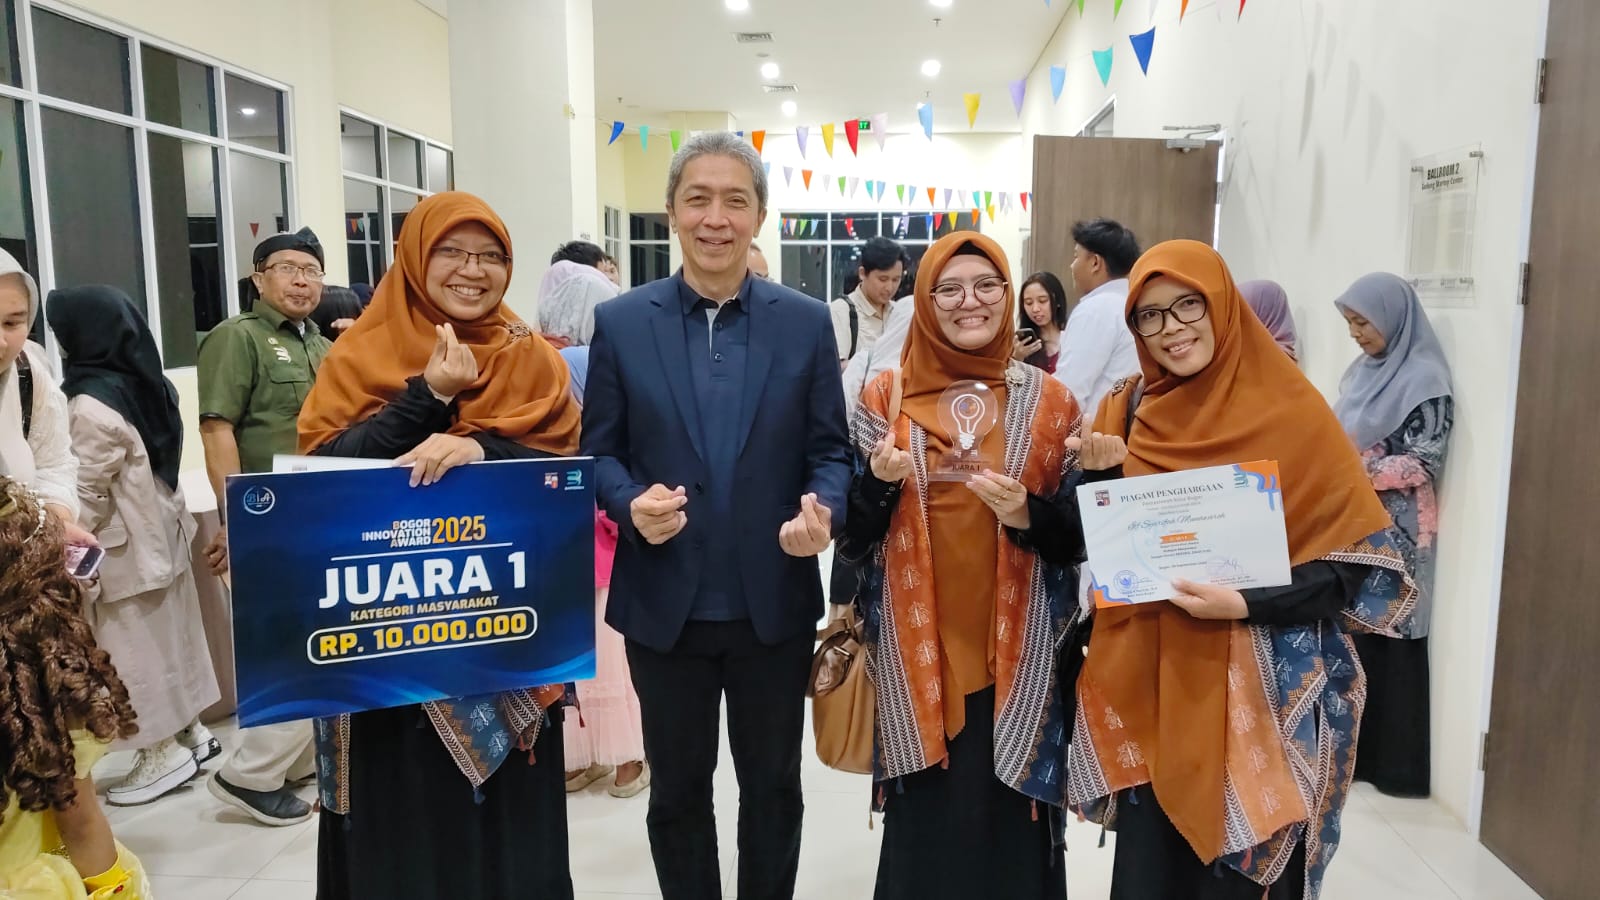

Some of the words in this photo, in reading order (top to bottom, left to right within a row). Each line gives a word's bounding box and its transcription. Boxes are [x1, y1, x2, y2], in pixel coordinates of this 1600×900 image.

[1427, 163, 1455, 180] BALLROOM
[1455, 162, 1460, 175] 2
[952, 464, 975, 472] JUARA
[1120, 491, 1154, 503] PIAGAM
[1156, 482, 1224, 498] PENGHARGAAN
[392, 518, 431, 530] BOGOR
[432, 515, 487, 544] 2025
[361, 527, 431, 542] INNOVATION
[390, 537, 431, 548] AWARD
[319, 554, 493, 609] JUARA
[508, 551, 526, 589] 1
[350, 604, 414, 622] KATEGORI
[417, 595, 499, 615] MASYARAKAT
[319, 634, 364, 658] RP.
[373, 613, 528, 650] 10.000.000
